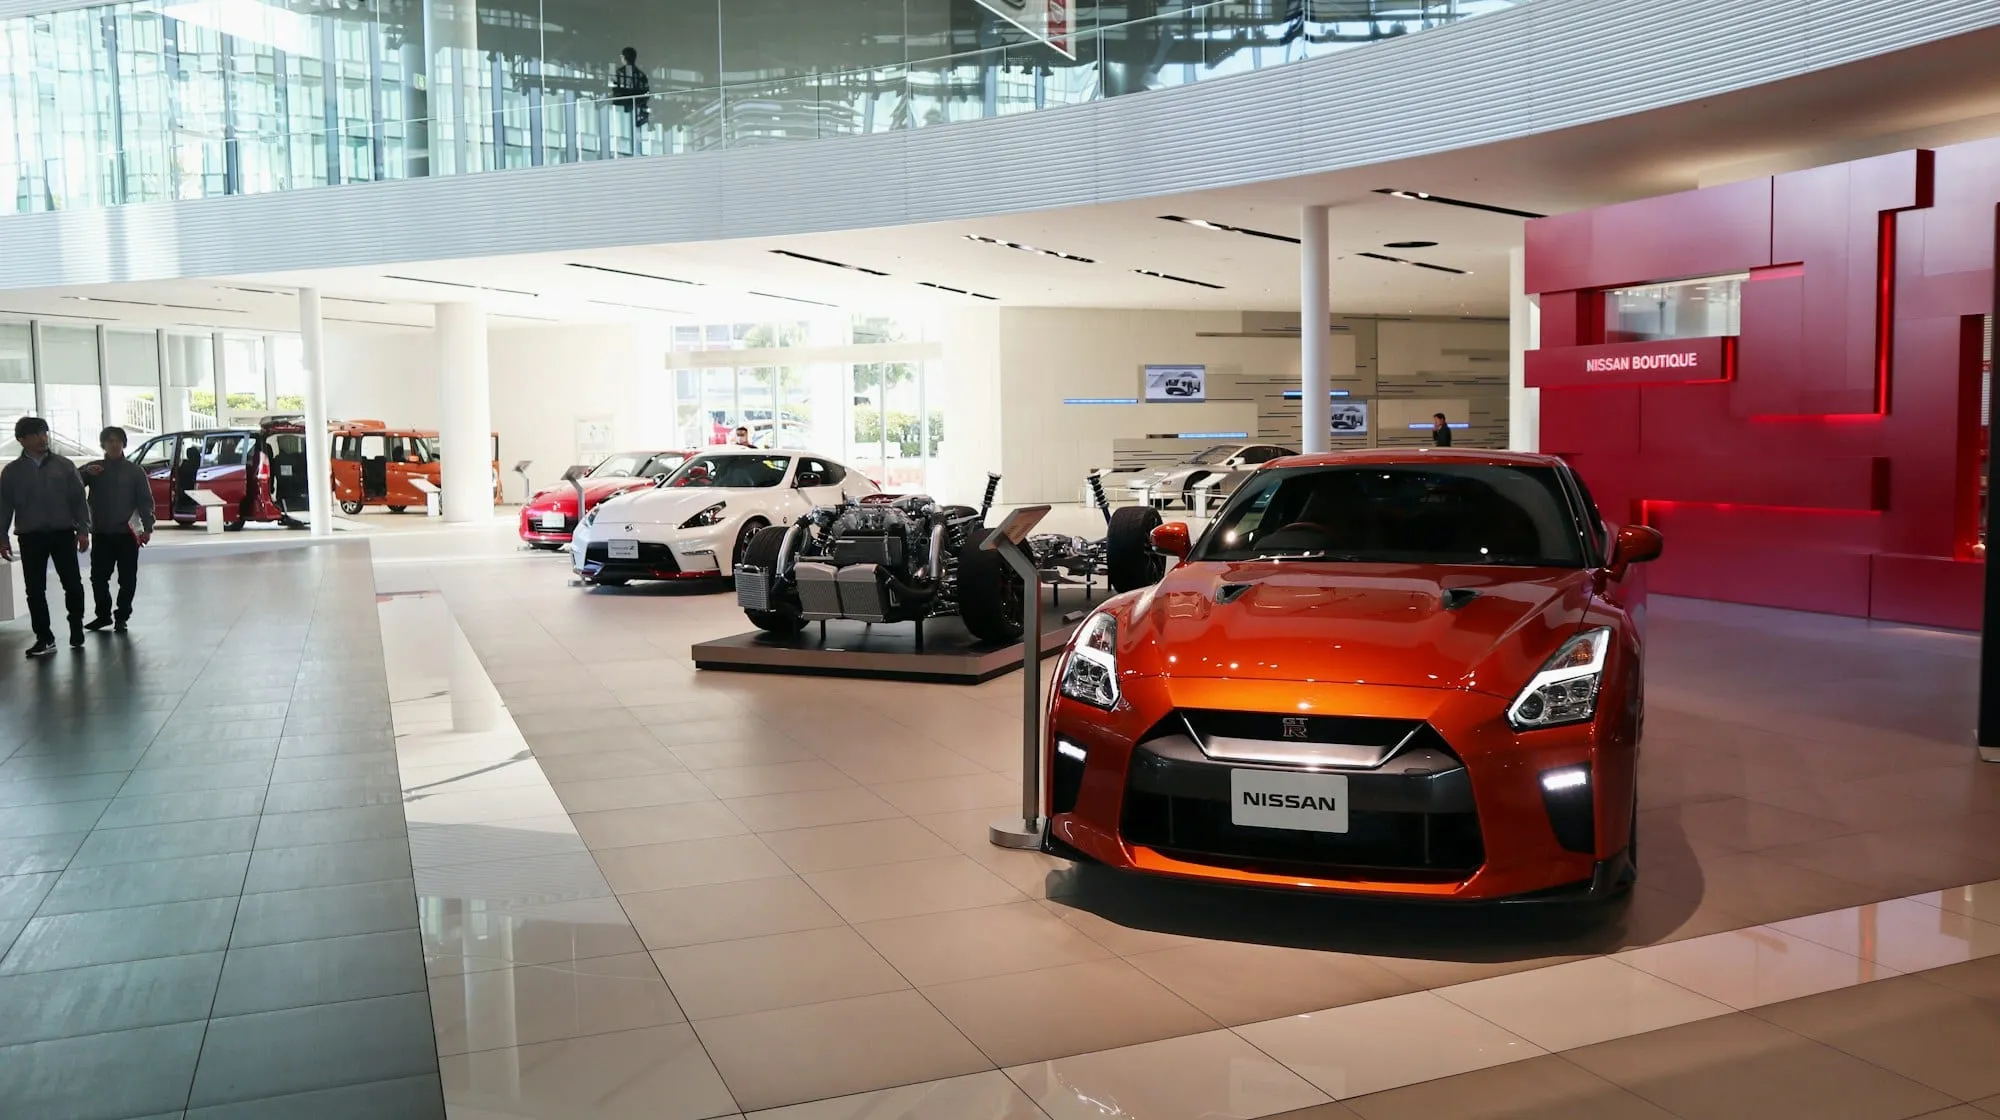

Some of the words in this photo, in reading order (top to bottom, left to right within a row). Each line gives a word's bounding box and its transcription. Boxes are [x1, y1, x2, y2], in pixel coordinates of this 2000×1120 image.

[1586, 357, 1630, 372] NISSAN
[1632, 352, 1698, 370] BOUTIQUE
[1243, 791, 1336, 811] NISSAN
